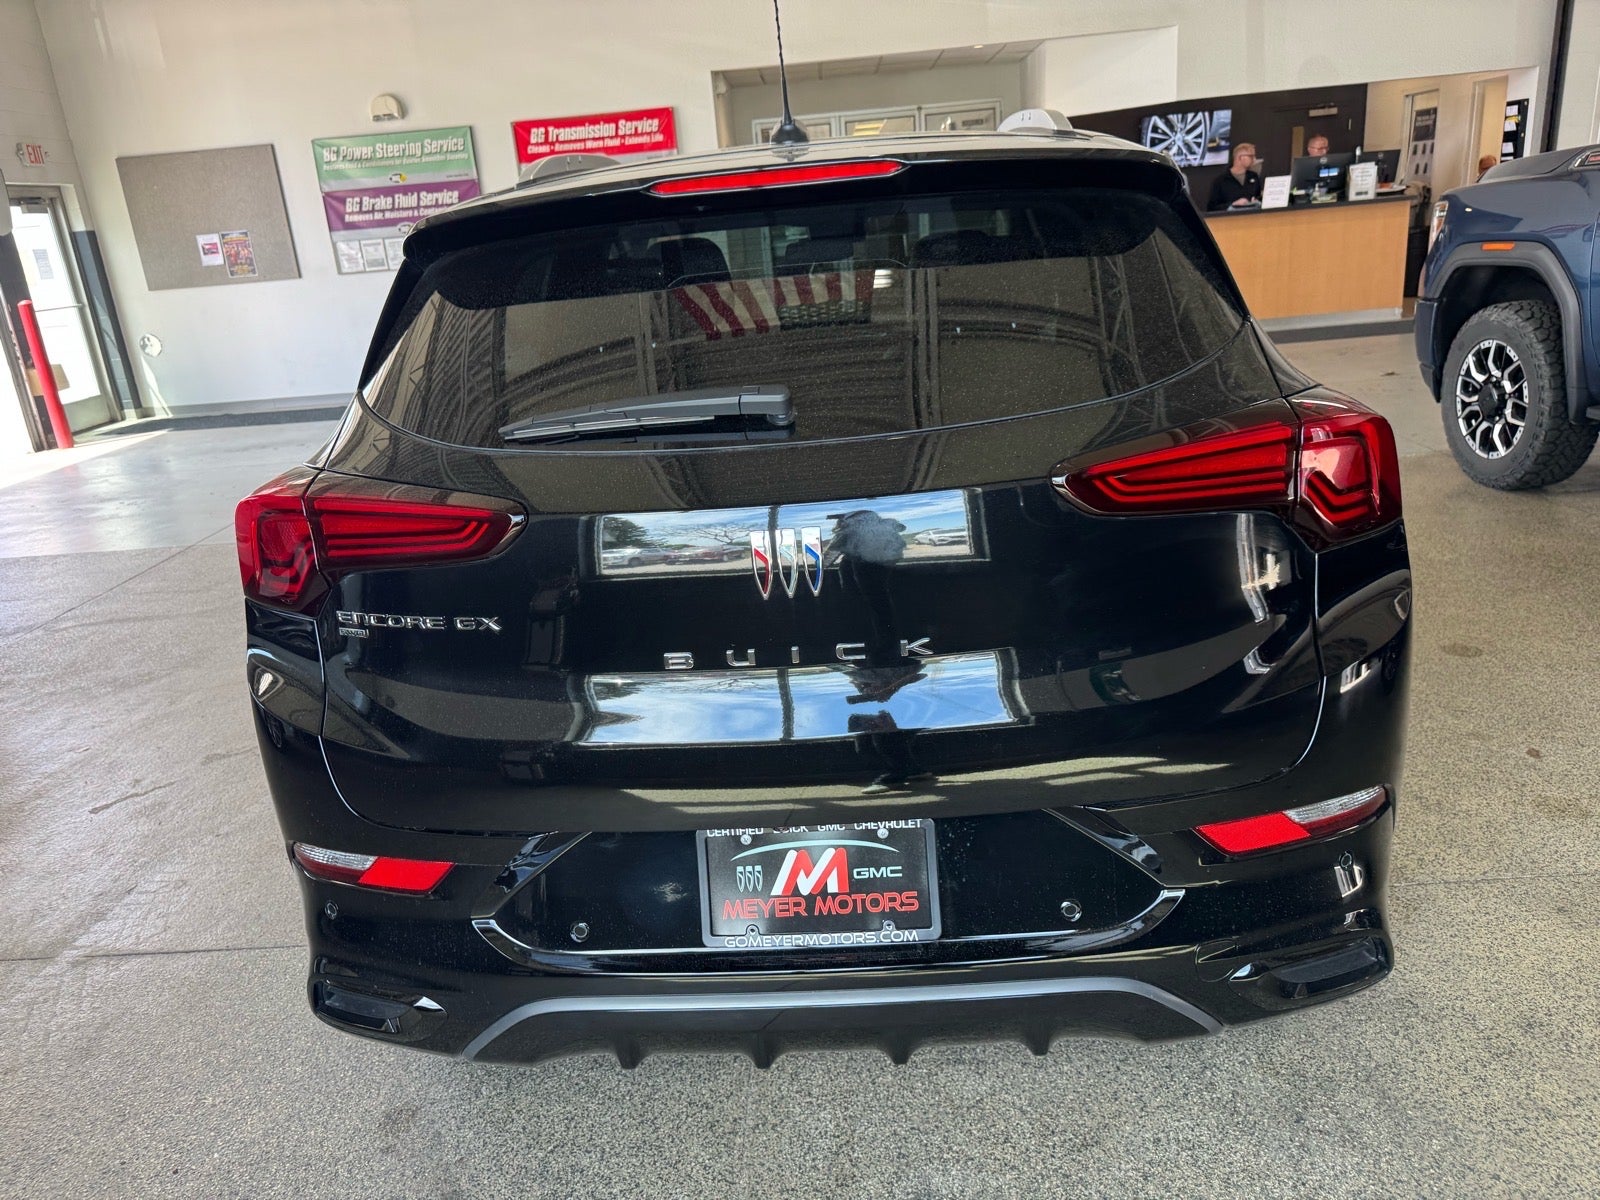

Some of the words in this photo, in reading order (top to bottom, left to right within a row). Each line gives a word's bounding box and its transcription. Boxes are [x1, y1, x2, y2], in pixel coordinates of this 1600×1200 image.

[530, 127, 545, 144] BG
[548, 122, 616, 142] Transmission
[618, 118, 660, 136] Service
[26, 144, 45, 164] EXIT
[323, 146, 338, 163] BG
[339, 144, 374, 161] Power
[375, 140, 422, 160] Steering
[424, 136, 465, 154] Service
[345, 197, 361, 213] BG
[362, 195, 393, 212] Brake
[394, 192, 418, 208] Fluid
[420, 189, 460, 206] Service
[345, 212, 373, 223] Removes
[336, 610, 447, 630] ENCORE
[454, 616, 503, 631] GX
[663, 637, 934, 670] BUICK
[773, 825, 808, 834] ICK
[854, 818, 923, 830] CHEVROLET
[853, 866, 903, 879] GMC
[722, 897, 808, 920] MEYER
[814, 891, 919, 916] MOTORS
[724, 930, 919, 947] GOMEYERMOTORS.COM
